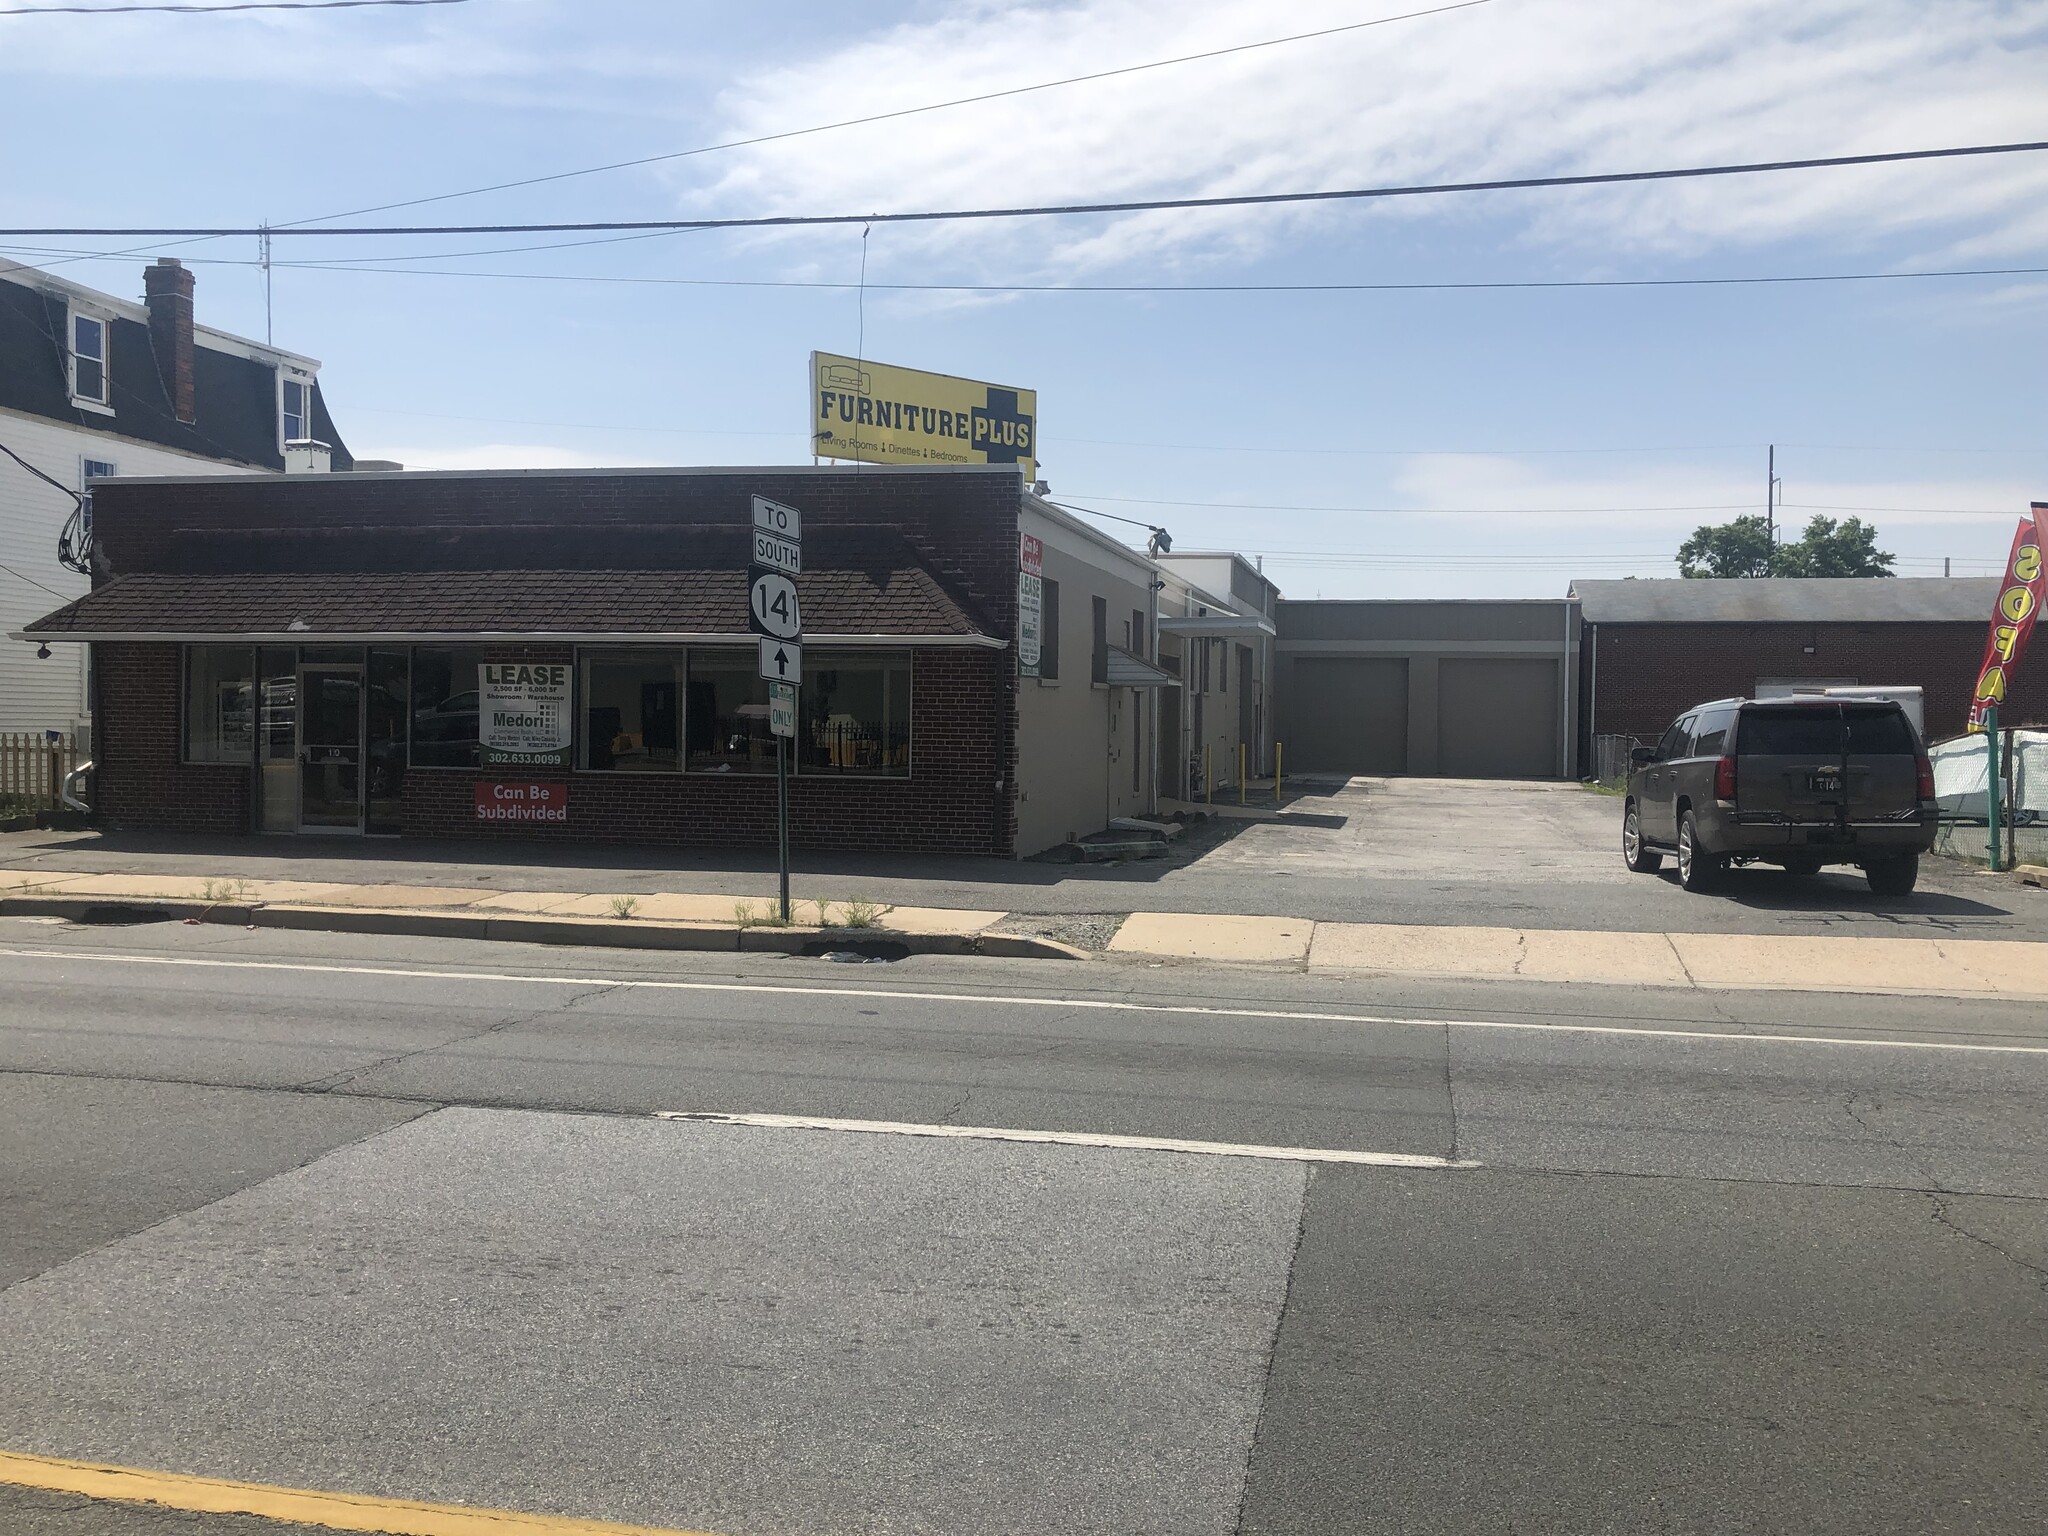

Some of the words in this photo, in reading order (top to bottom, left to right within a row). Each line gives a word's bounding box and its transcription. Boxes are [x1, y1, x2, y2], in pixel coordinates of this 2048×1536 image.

[820, 390, 969, 440] FURNITURE
[974, 416, 1030, 448] PLUS
[821, 435, 847, 449] Living
[849, 438, 878, 451] Rooms
[889, 443, 921, 457] Dinettes
[930, 449, 968, 463] Bedrooms
[764, 505, 788, 529] TO
[757, 538, 799, 568] SOUTH
[759, 583, 798, 629] 141
[485, 665, 565, 686] LEASE
[493, 712, 544, 728] Medori
[772, 708, 792, 727] ONLY
[488, 752, 561, 765] 302.633.0099
[493, 784, 524, 800] Can
[529, 785, 550, 800] Be
[477, 804, 568, 821] Subdivided
